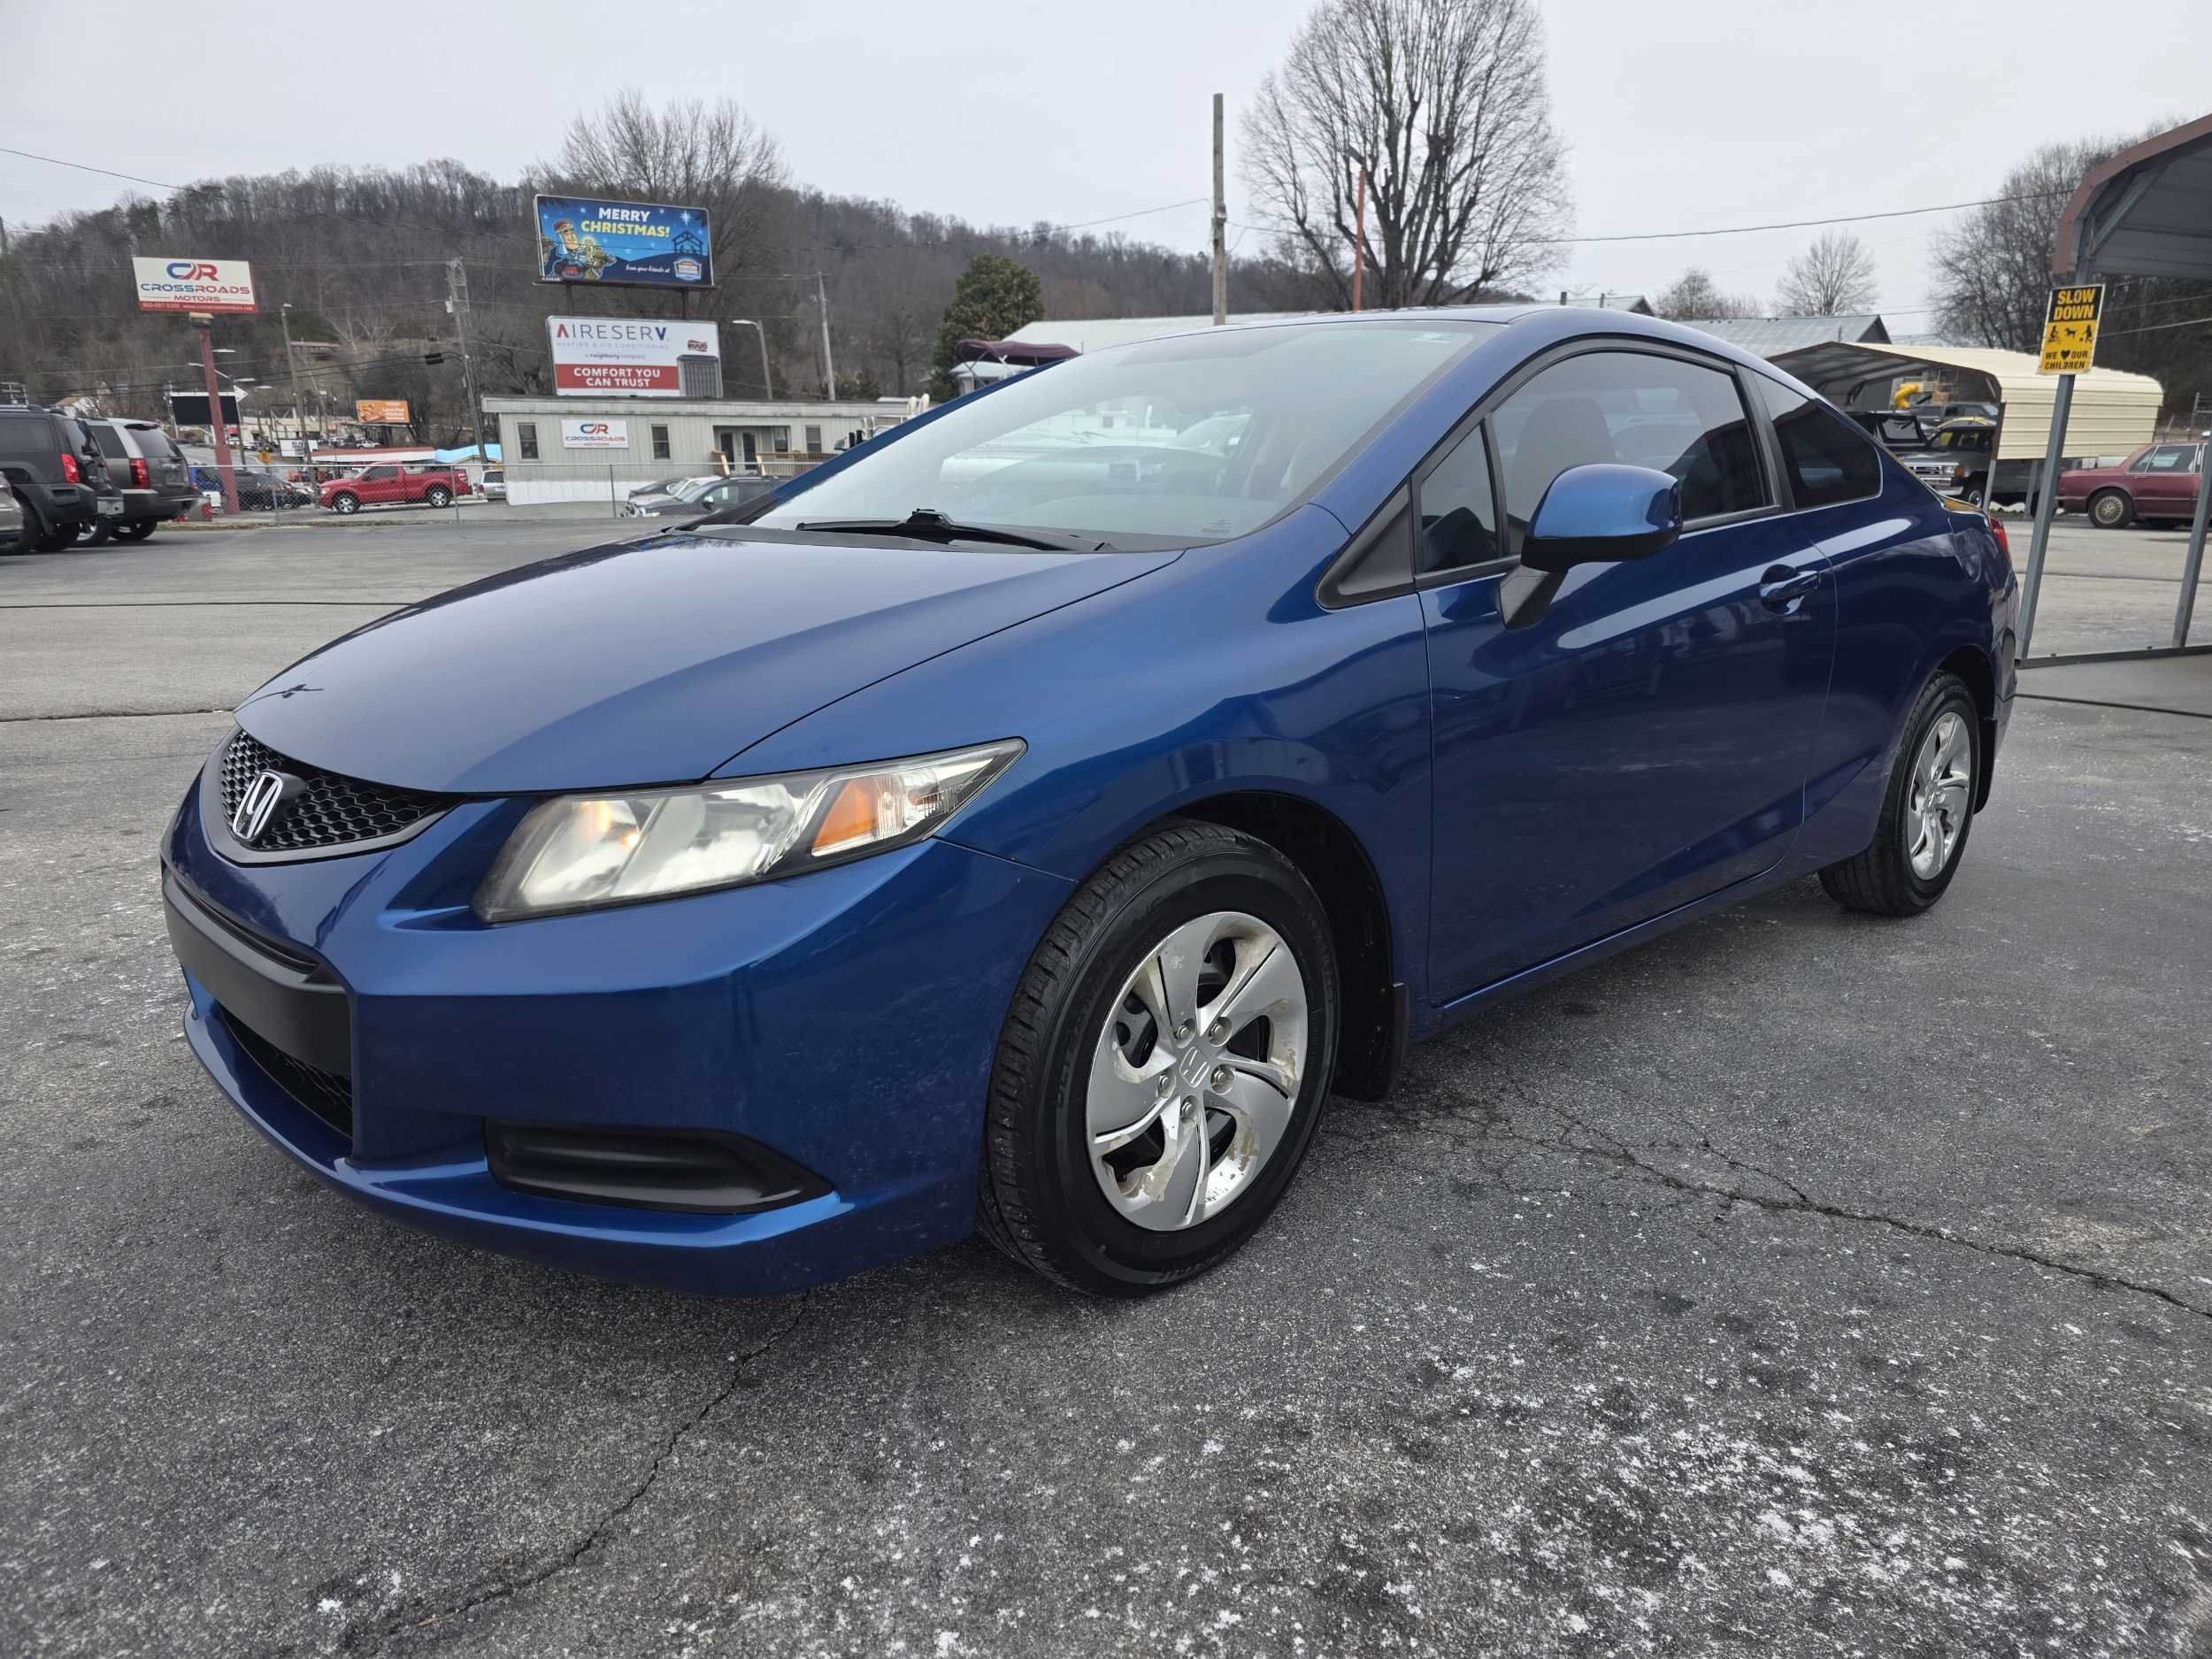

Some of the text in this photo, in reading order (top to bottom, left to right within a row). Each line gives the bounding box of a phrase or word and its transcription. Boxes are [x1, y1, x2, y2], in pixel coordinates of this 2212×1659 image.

[598, 207, 650, 222] MERRY
[580, 220, 671, 238] CHRISTMAS!
[141, 283, 250, 294] CROSSROADS
[2057, 288, 2096, 305] SLOW
[2054, 304, 2094, 320] DOWN
[557, 324, 667, 341] AIRESERV
[2046, 350, 2088, 359] WE OUR
[2045, 361, 2085, 370] CHILDREN
[573, 368, 661, 378] COMFORT YOU
[586, 378, 650, 388] CAN TRUST
